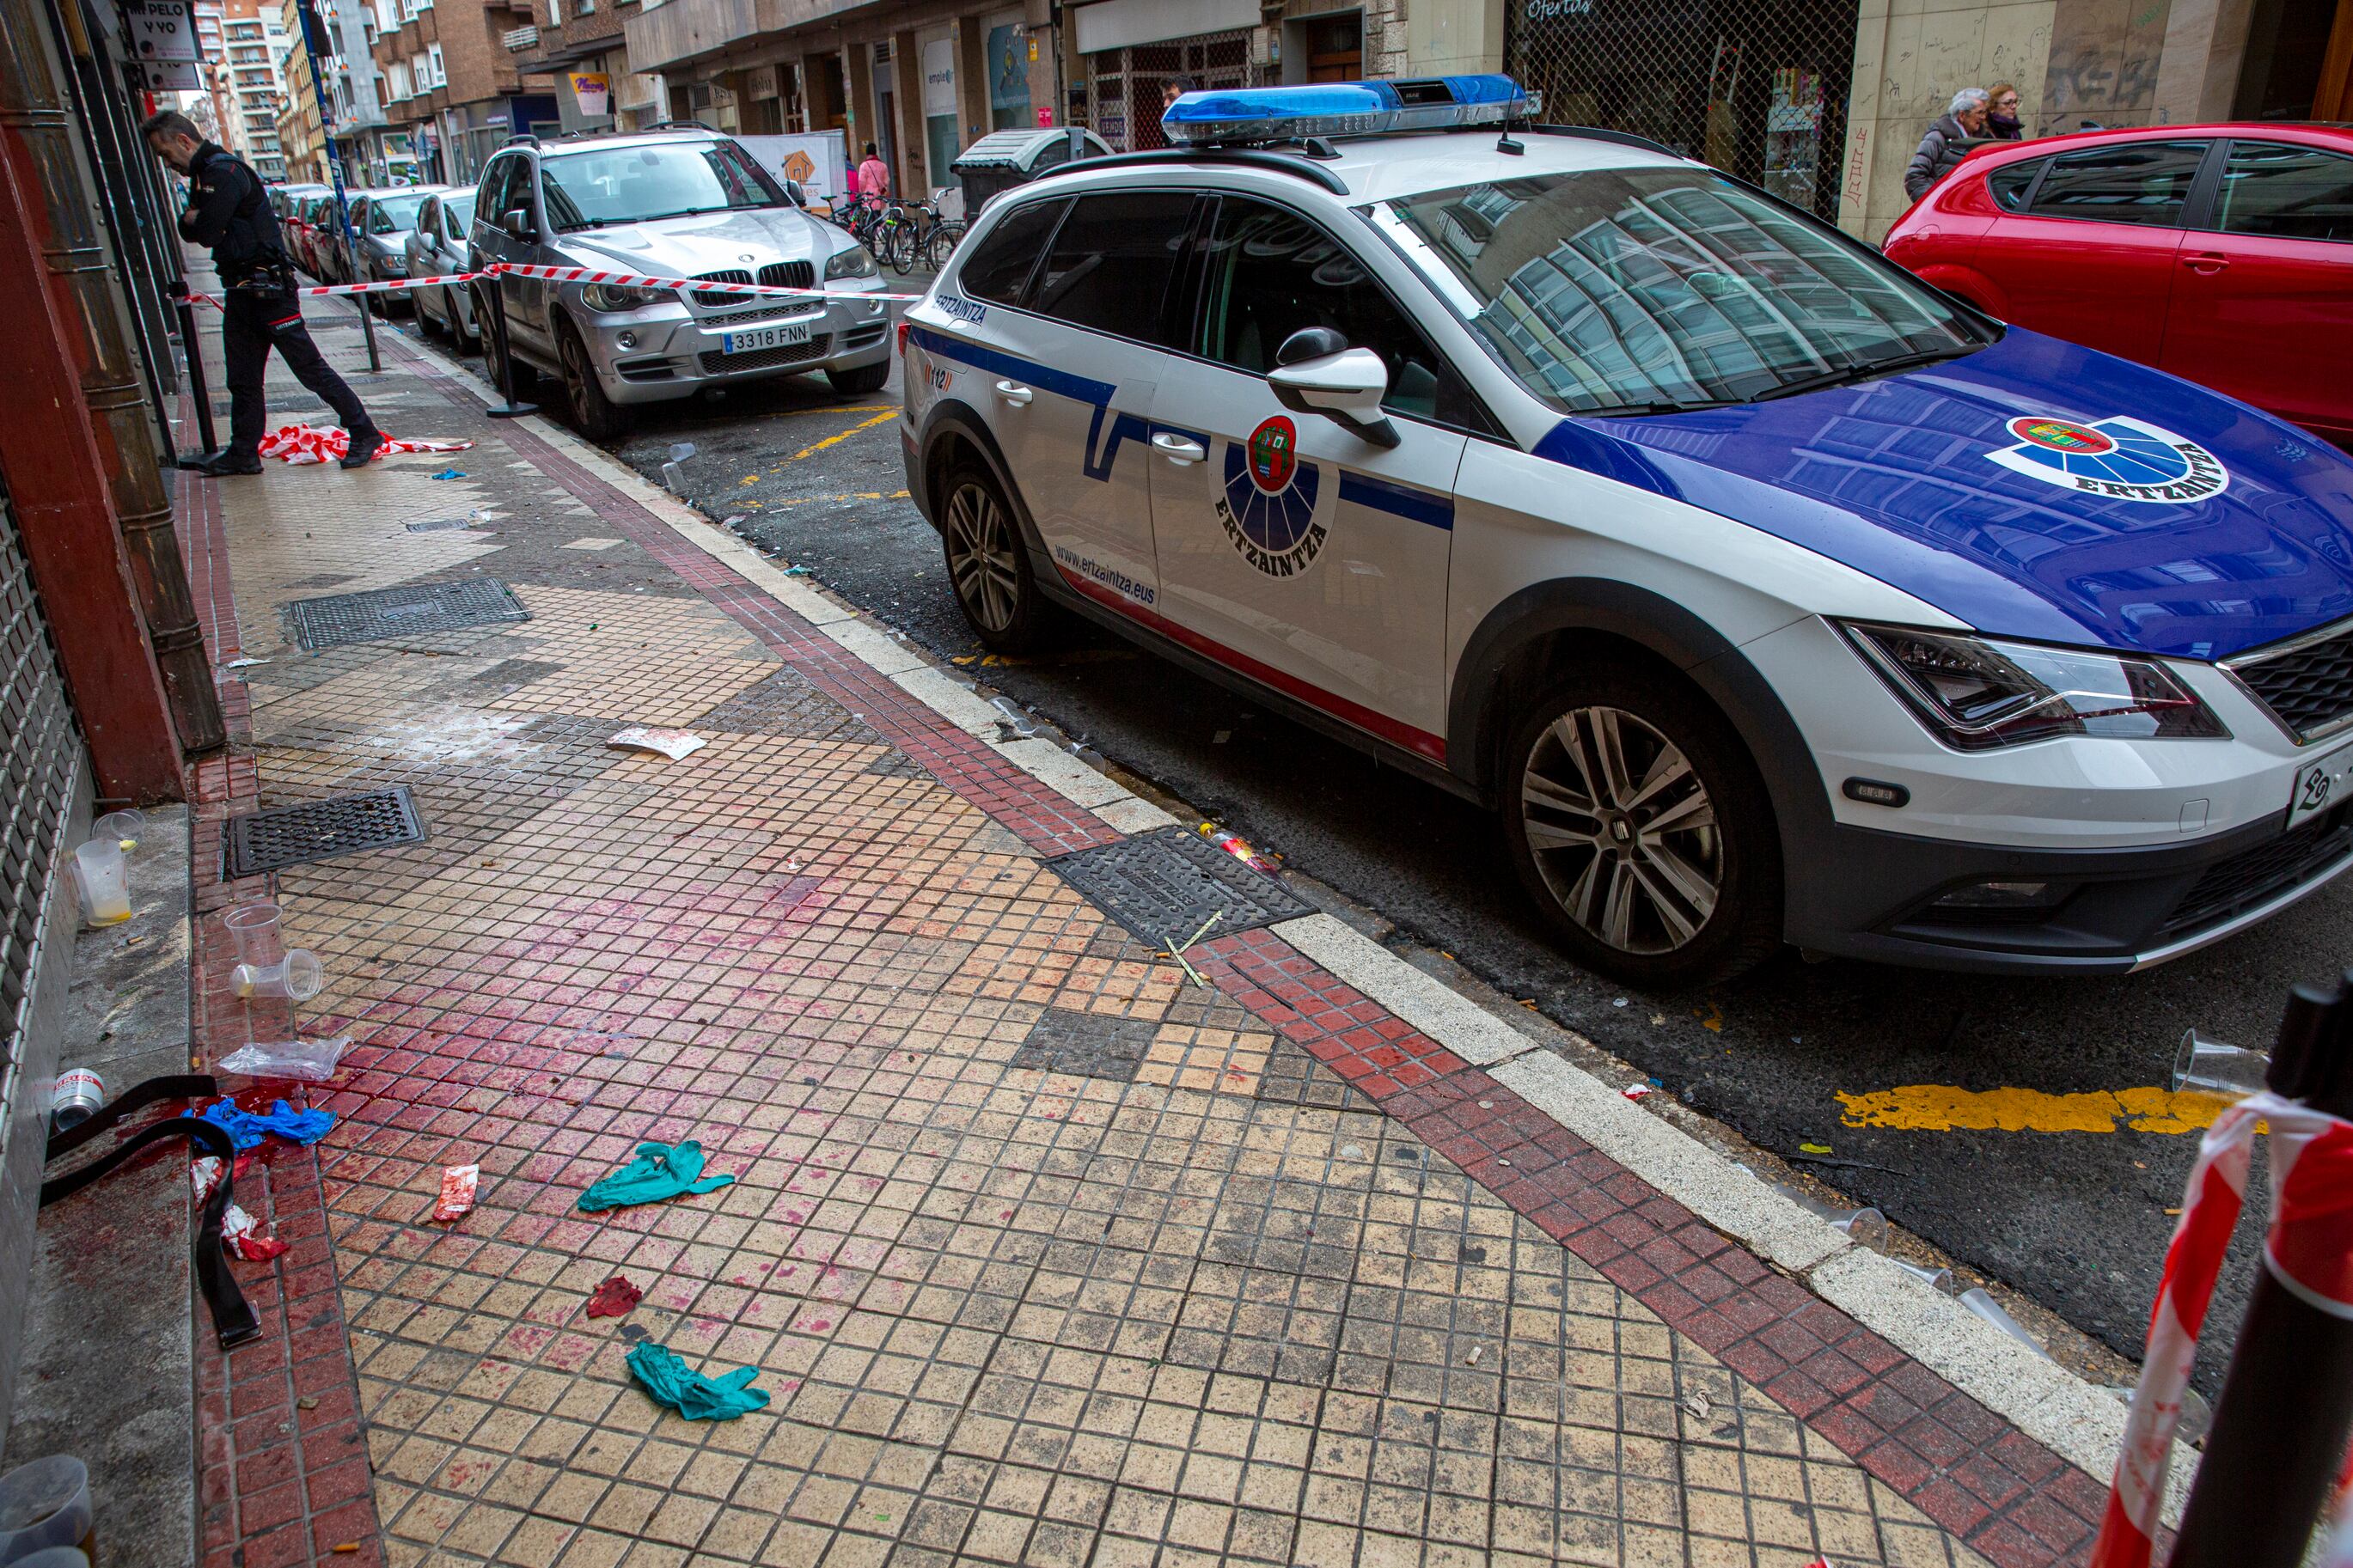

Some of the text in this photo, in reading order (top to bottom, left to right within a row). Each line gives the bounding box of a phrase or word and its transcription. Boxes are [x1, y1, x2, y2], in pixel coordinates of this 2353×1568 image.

[148, 3, 183, 15] PELO
[144, 21, 175, 34] Y YO
[932, 295, 987, 324] ERTZAINTZA
[736, 325, 807, 349] 3318 FNN
[2075, 443, 2222, 500] ERTZAINTZA
[1215, 497, 1328, 577] ERTZAINTZA
[1055, 544, 1155, 604] www.ertzaintza.eus
